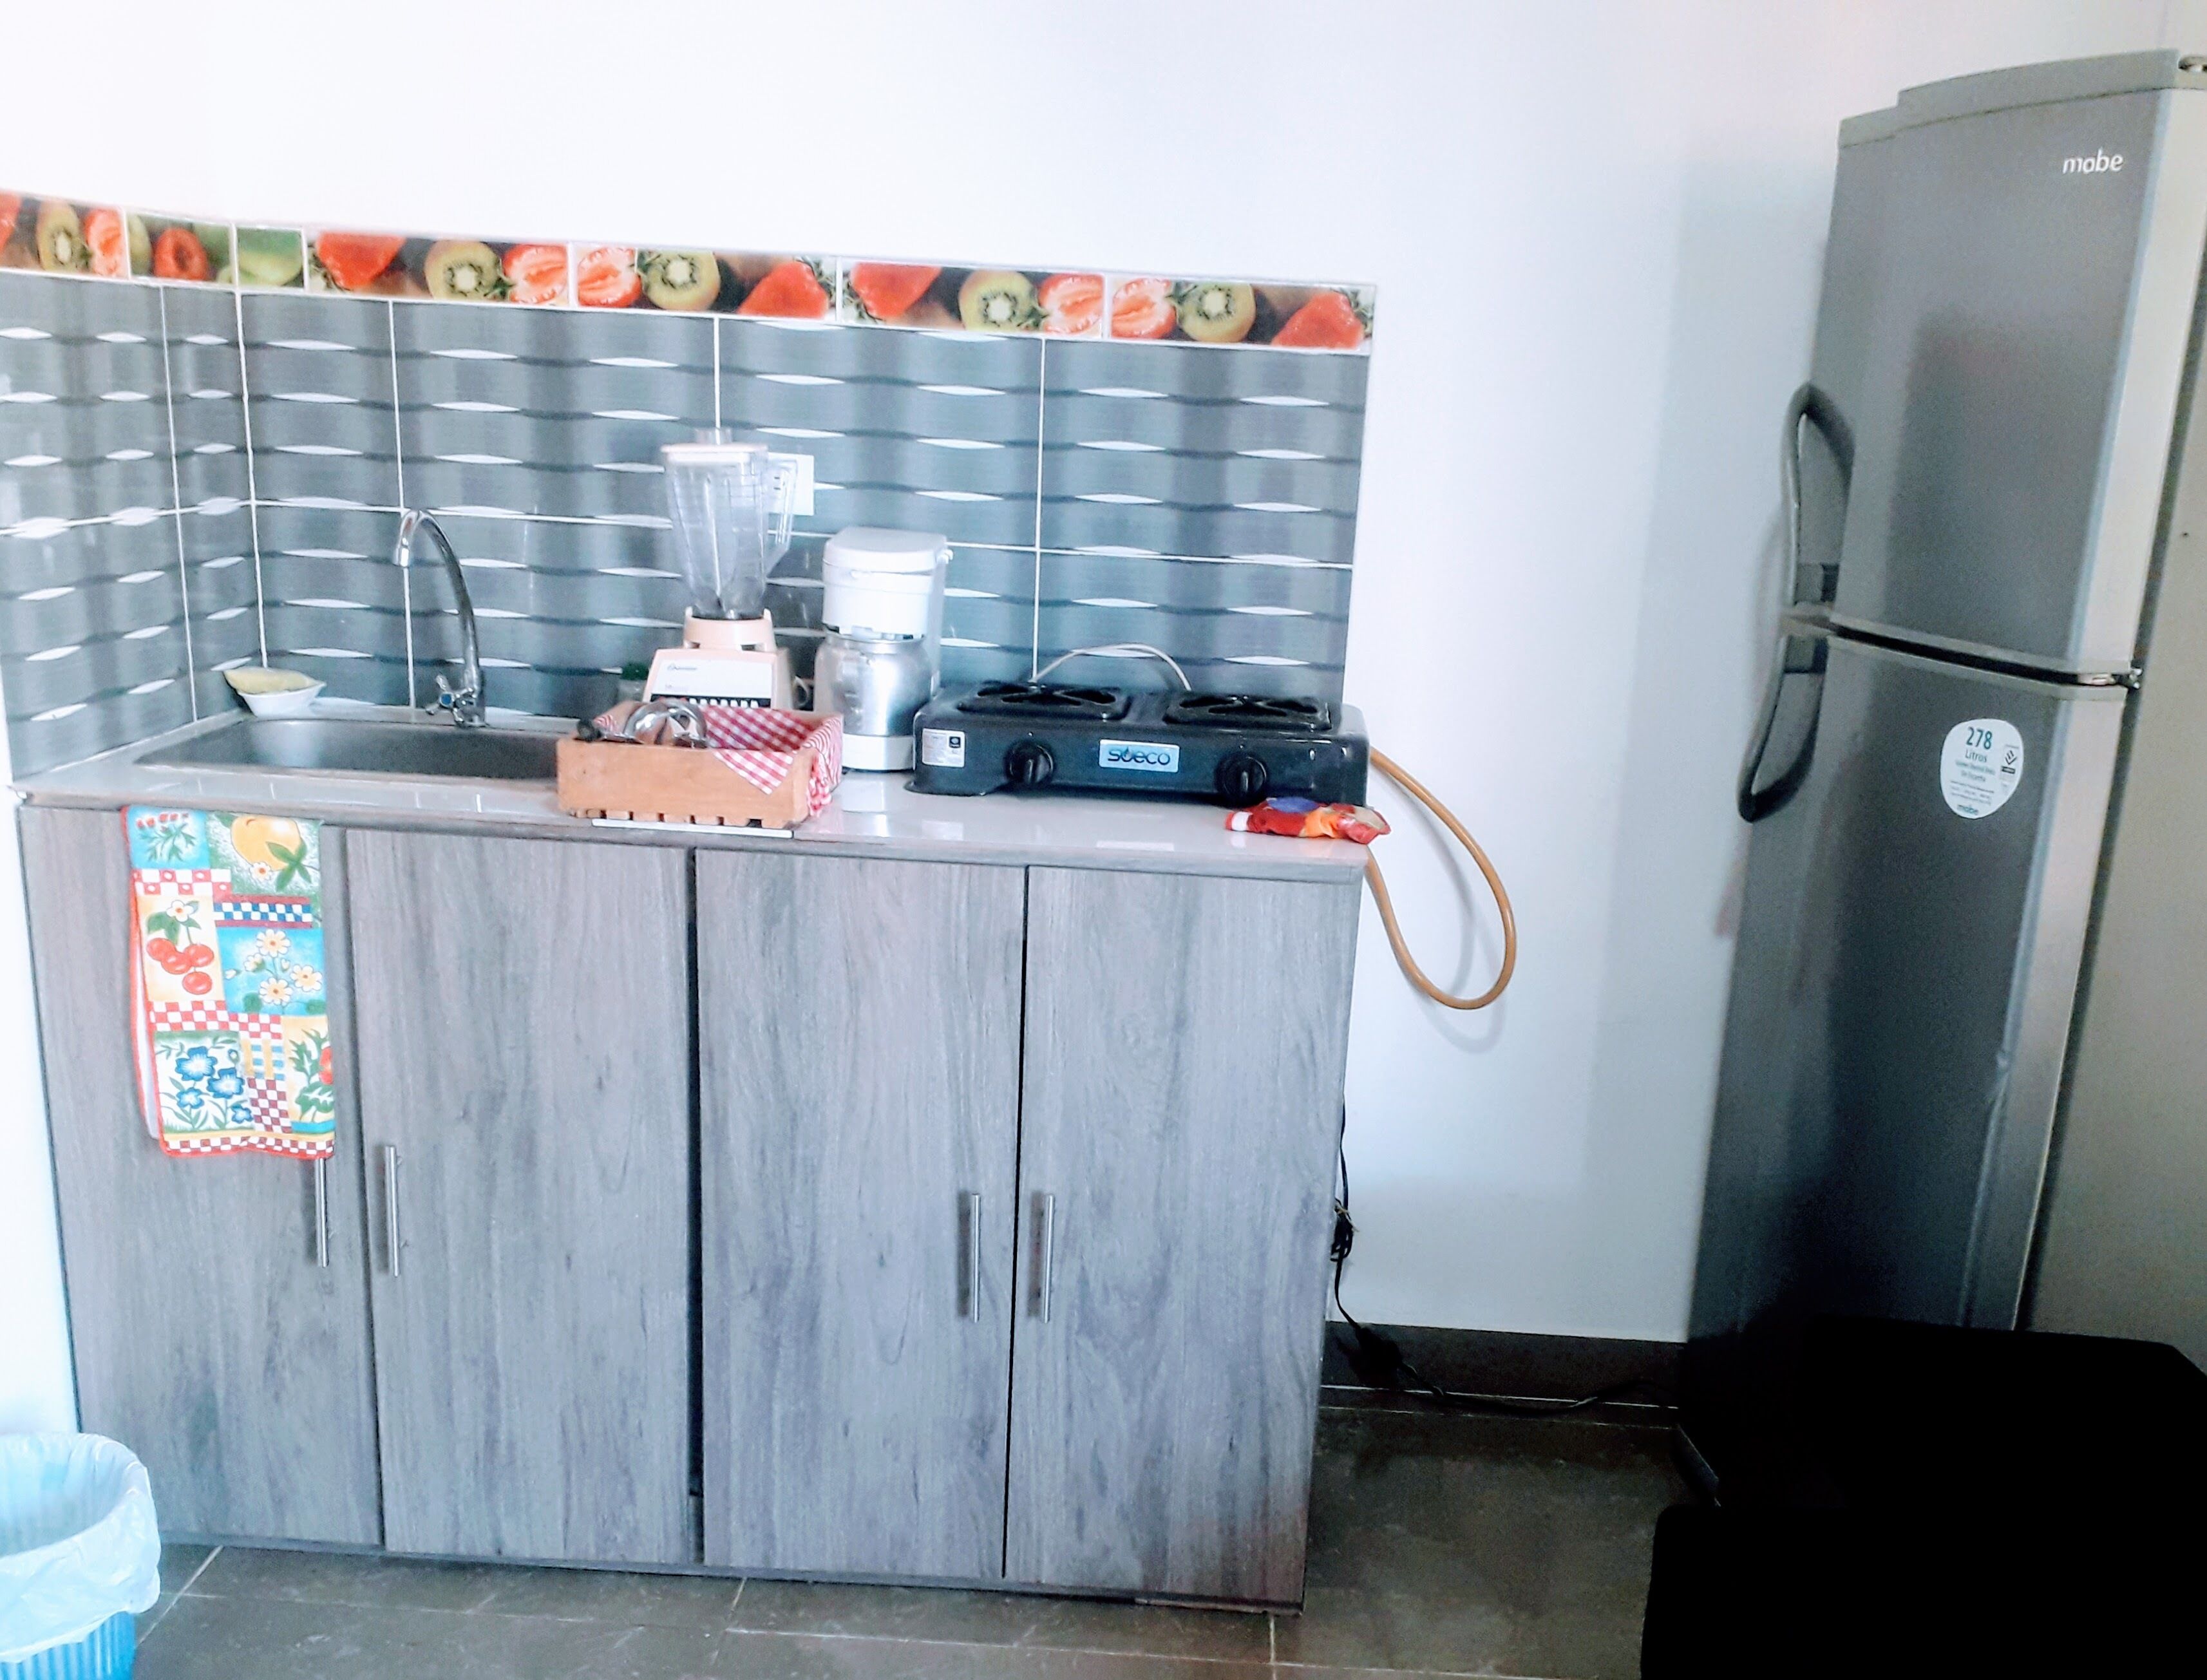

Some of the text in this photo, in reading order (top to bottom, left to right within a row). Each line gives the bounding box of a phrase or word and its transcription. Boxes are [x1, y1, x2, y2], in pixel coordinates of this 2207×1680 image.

[2062, 146, 2123, 173] mabe
[1966, 726, 1993, 750] 278
[1965, 750, 1987, 762] Litros
